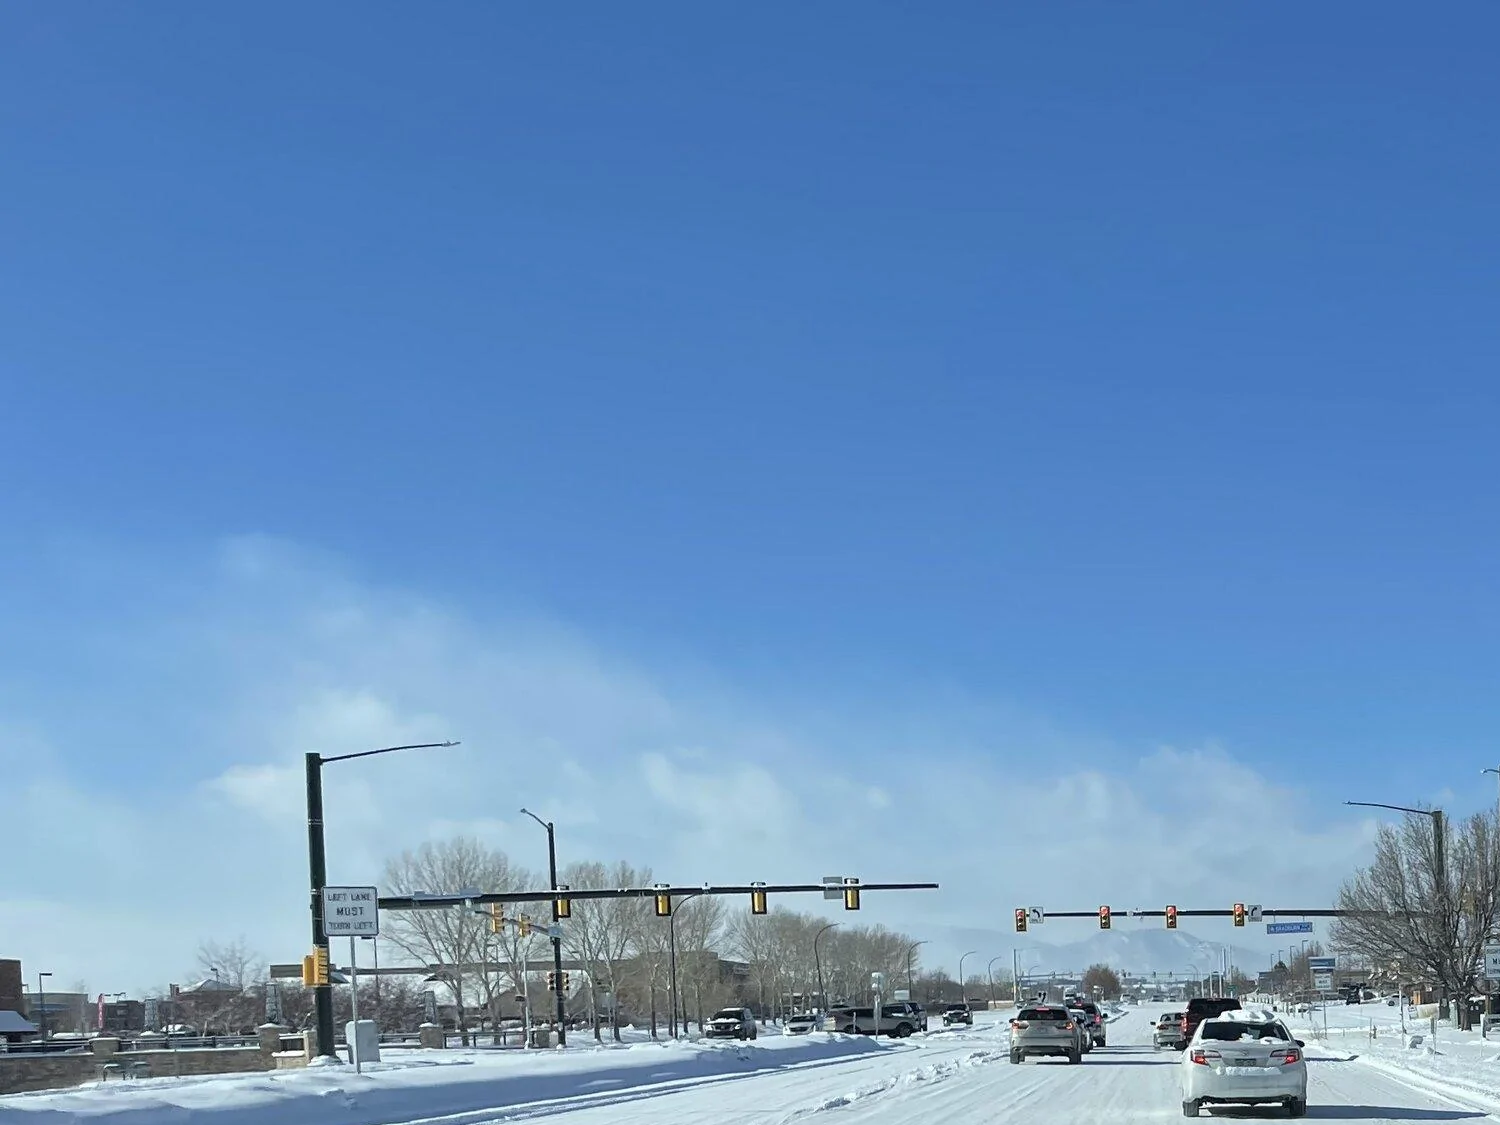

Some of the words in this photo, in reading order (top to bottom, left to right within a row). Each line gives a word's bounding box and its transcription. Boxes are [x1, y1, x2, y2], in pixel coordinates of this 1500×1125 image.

[327, 893, 346, 901] LEFT
[350, 893, 371, 901] LANE
[336, 906, 364, 916] MUST
